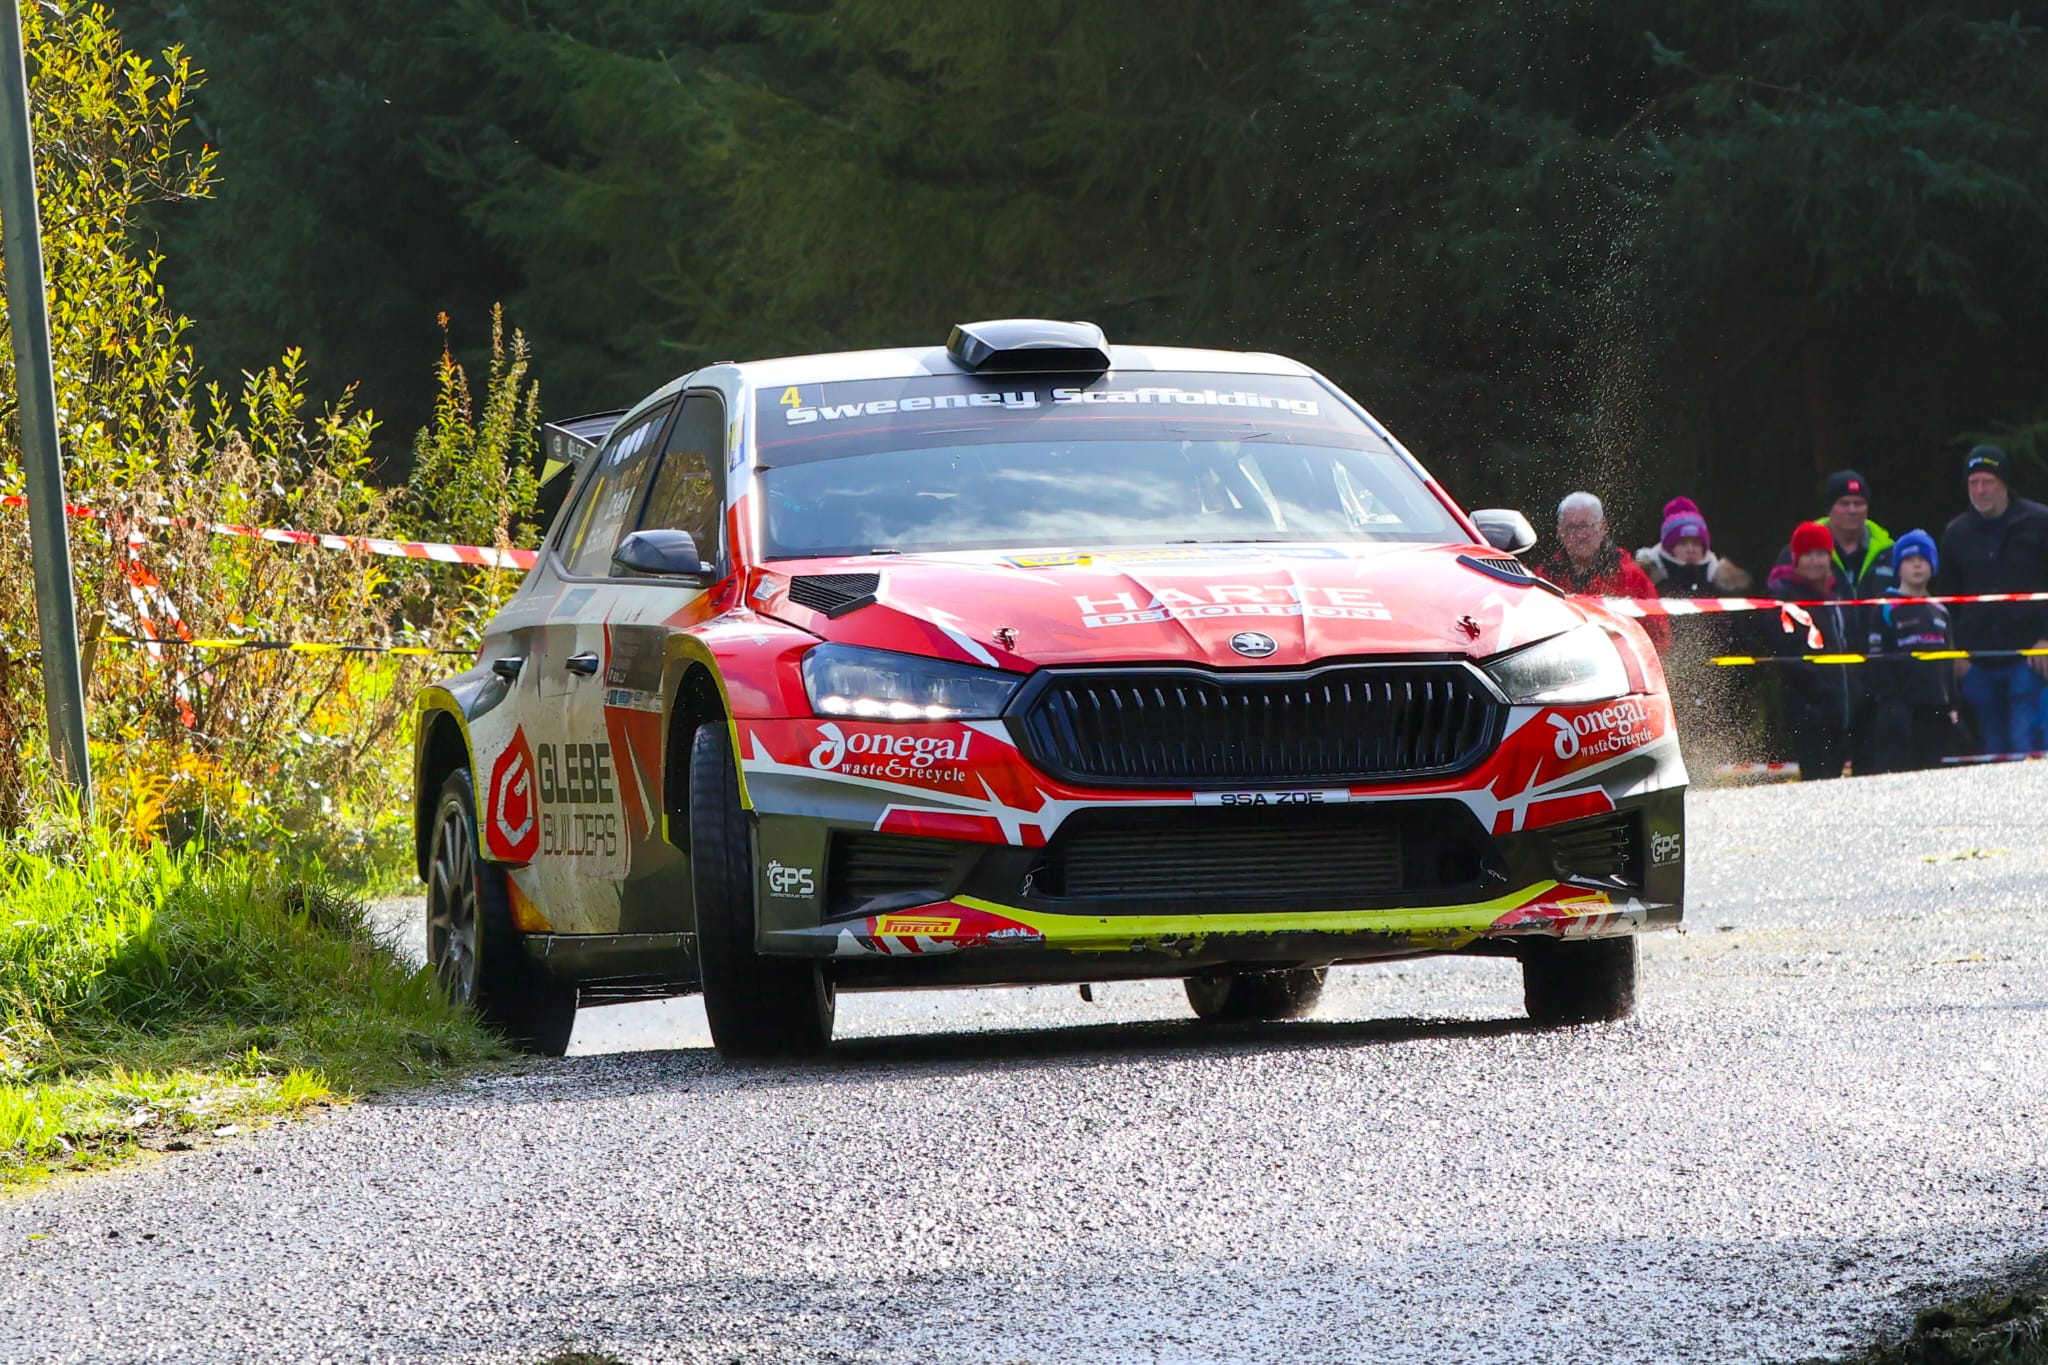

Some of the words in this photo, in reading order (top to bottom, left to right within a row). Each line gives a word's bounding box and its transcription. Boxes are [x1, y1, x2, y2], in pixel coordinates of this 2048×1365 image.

[779, 386, 803, 408] 4
[785, 391, 1040, 426] Sweeney
[1052, 387, 1320, 416] Scaffolding
[1072, 585, 1385, 614] HARTE
[1098, 606, 1378, 625] DEMOLITON
[537, 743, 615, 804] GLEBE
[543, 813, 617, 857] BUILDERS
[883, 920, 953, 934] PIRELLI
